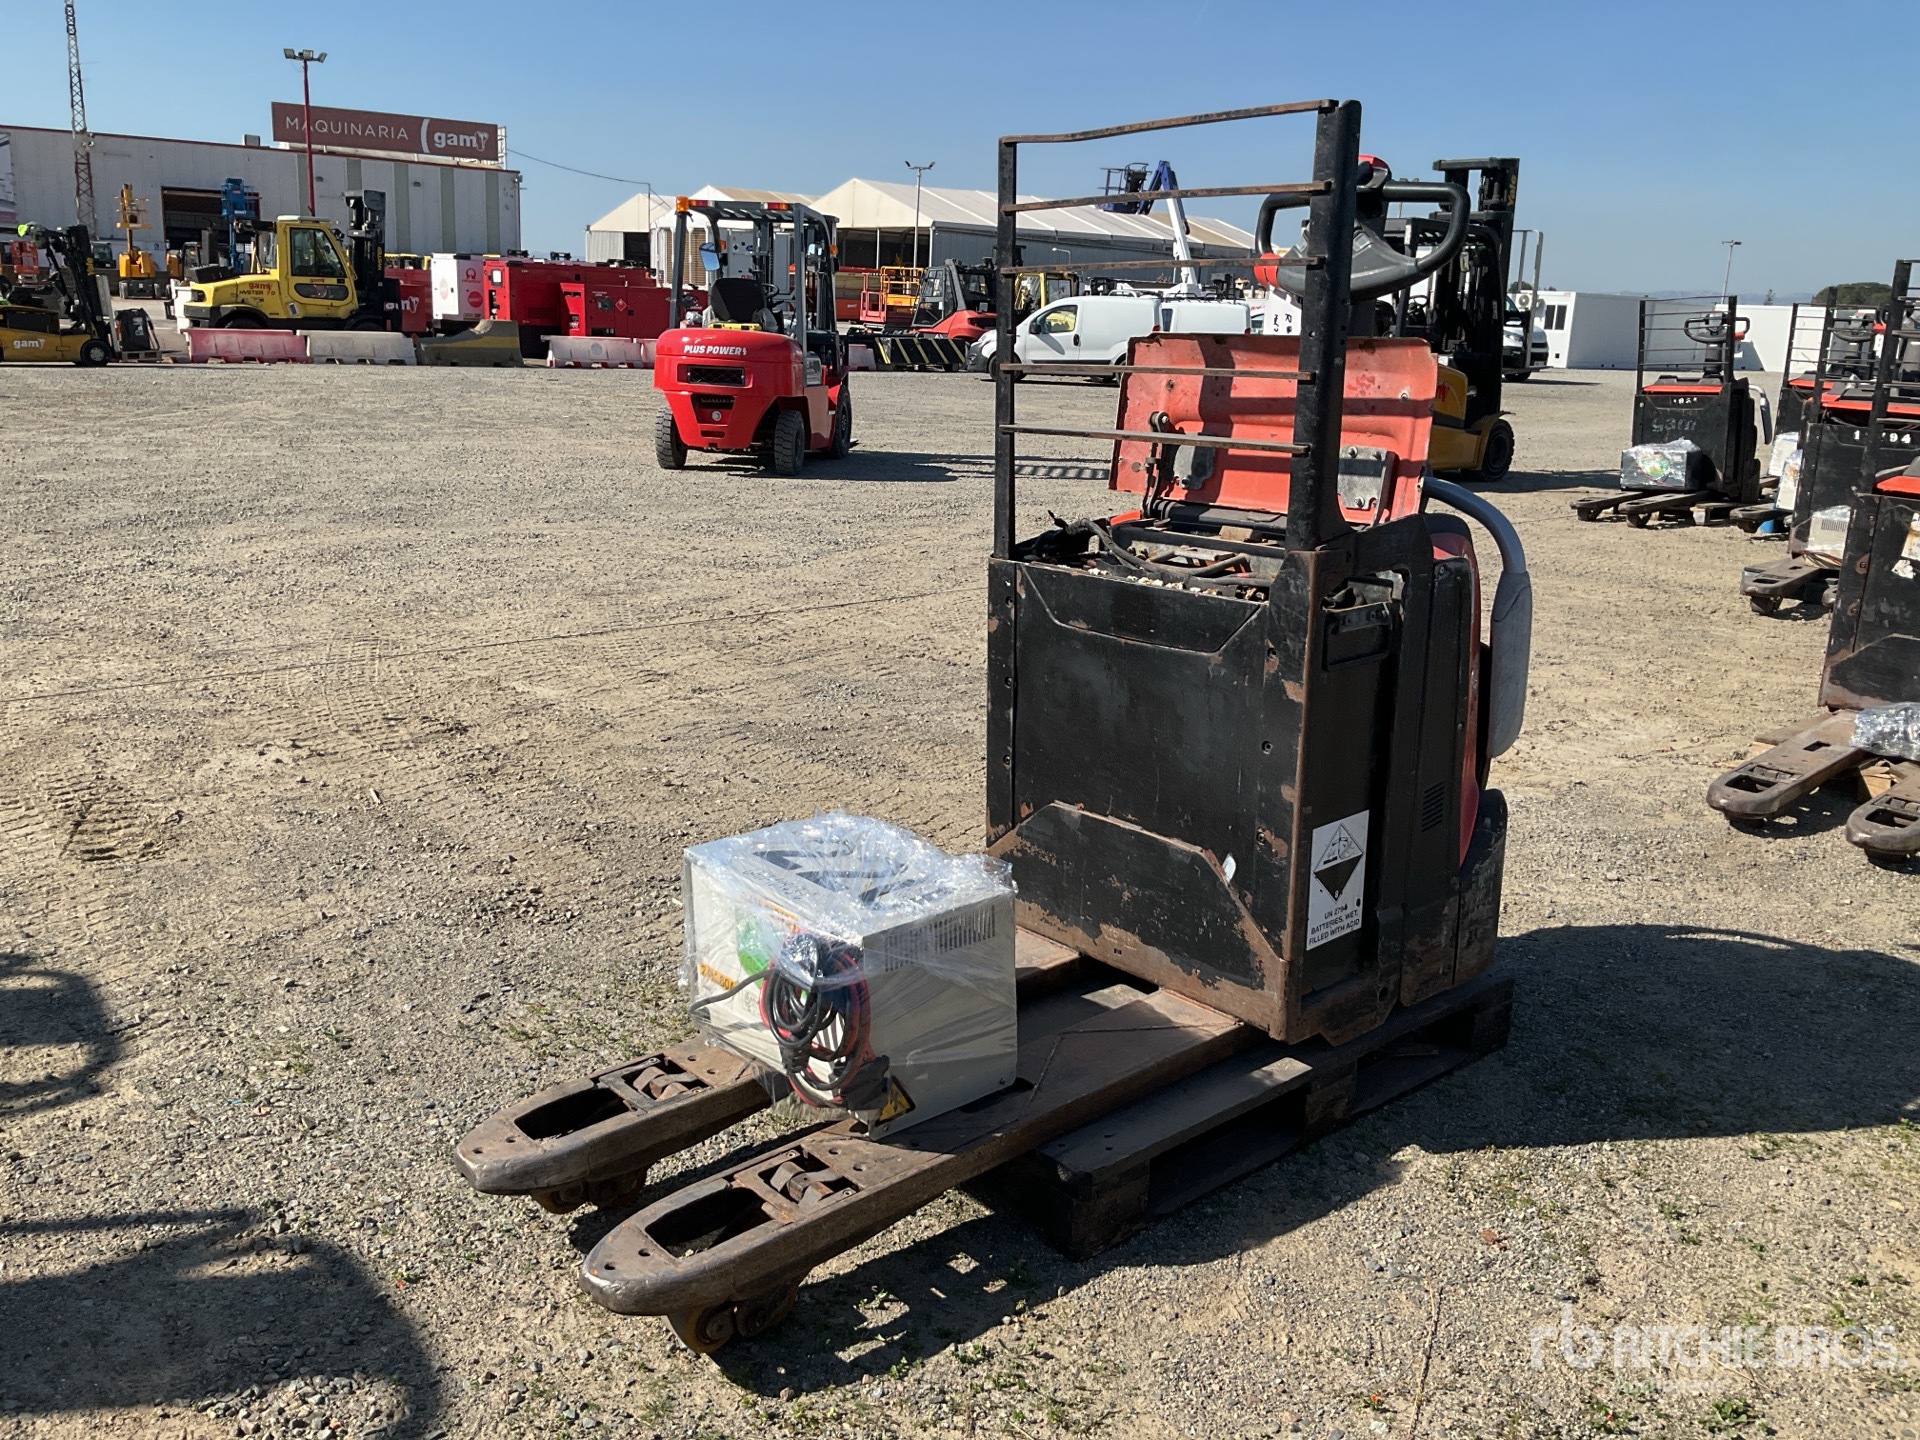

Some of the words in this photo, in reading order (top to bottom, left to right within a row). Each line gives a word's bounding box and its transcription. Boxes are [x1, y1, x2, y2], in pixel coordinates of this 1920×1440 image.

[285, 116, 409, 140] MAQUINARIA
[684, 344, 706, 354] PLUS
[706, 345, 742, 356] POWER
[1324, 911, 1333, 919] UN
[1309, 932, 1329, 945] FILLED
[1329, 924, 1346, 936] WITH
[1346, 918, 1360, 929] ACID
